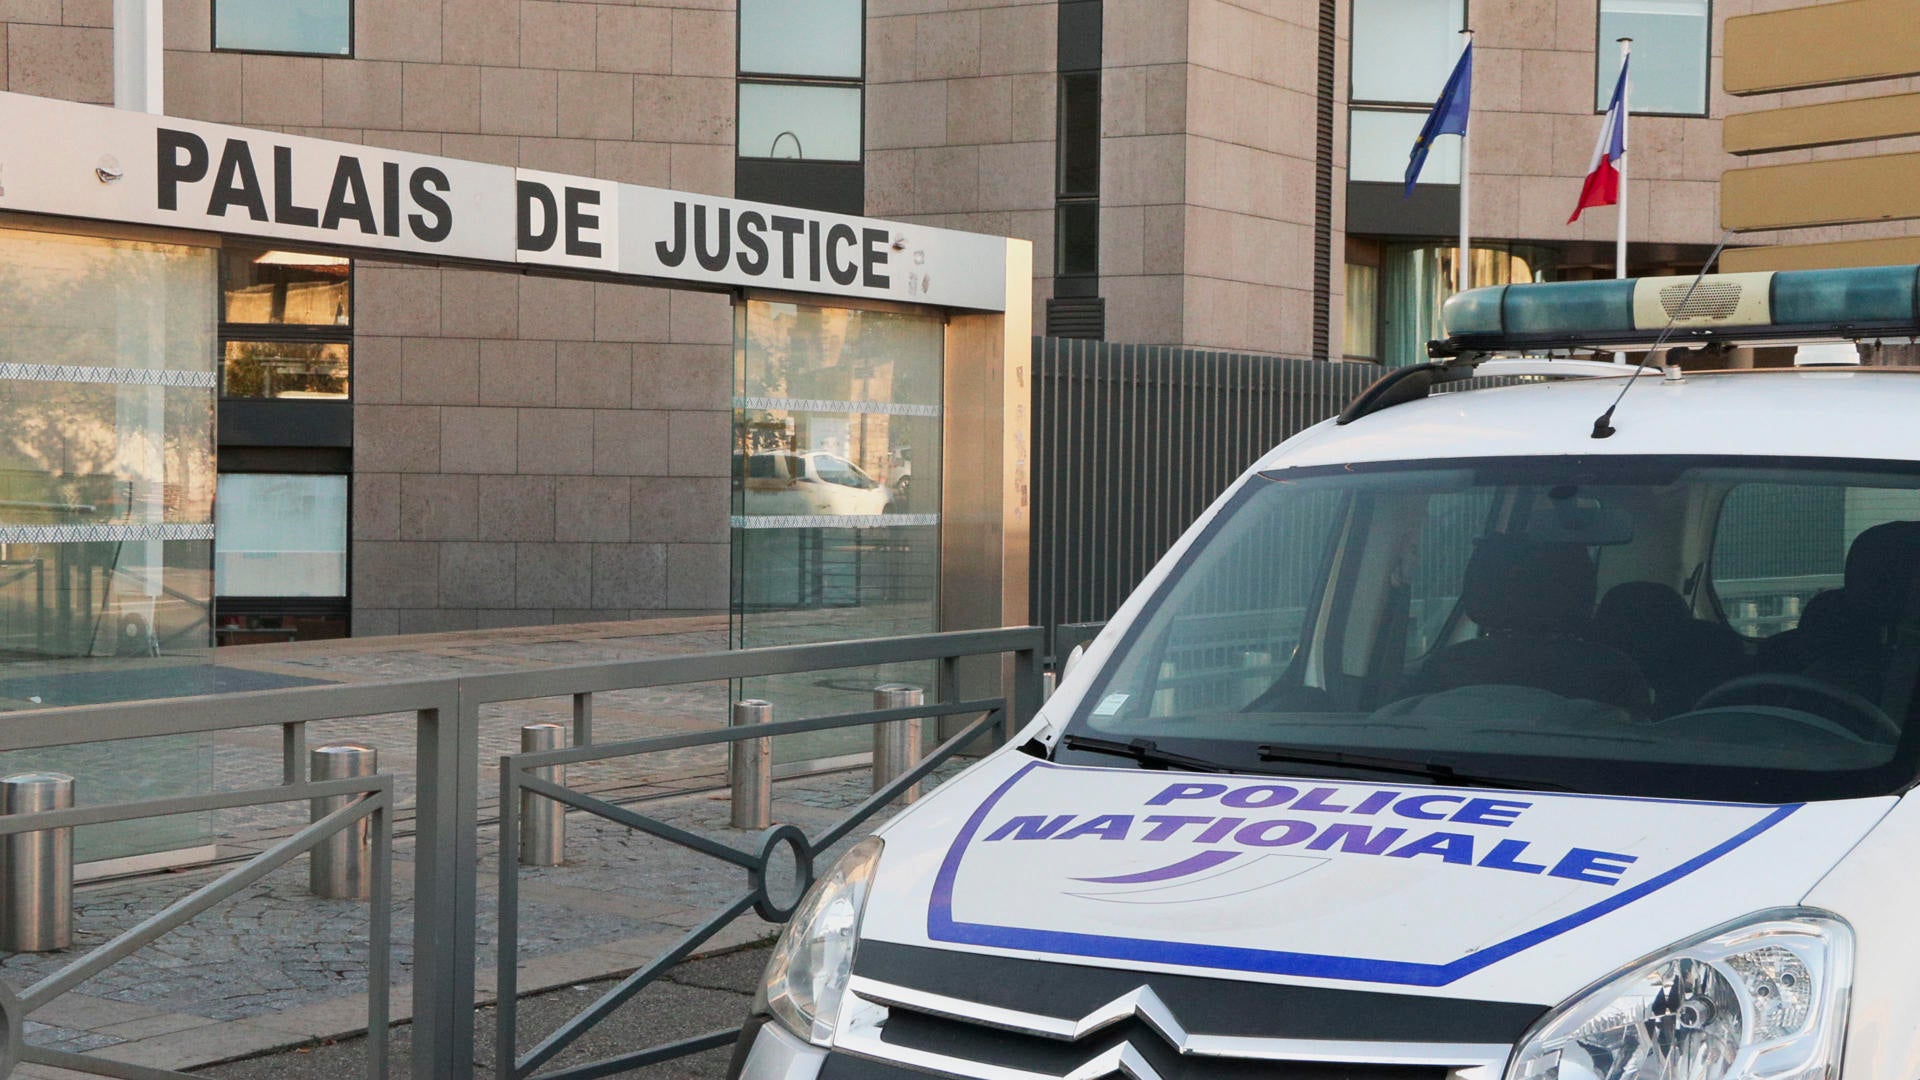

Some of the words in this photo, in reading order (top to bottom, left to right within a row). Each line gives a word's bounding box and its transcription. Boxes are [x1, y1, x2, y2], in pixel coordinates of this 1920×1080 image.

[157, 127, 452, 243] PALAIS
[516, 180, 602, 259] DE
[655, 202, 890, 289] JUSTICE
[1144, 783, 1532, 828] POLICE
[982, 815, 1639, 886] NATIONALE
